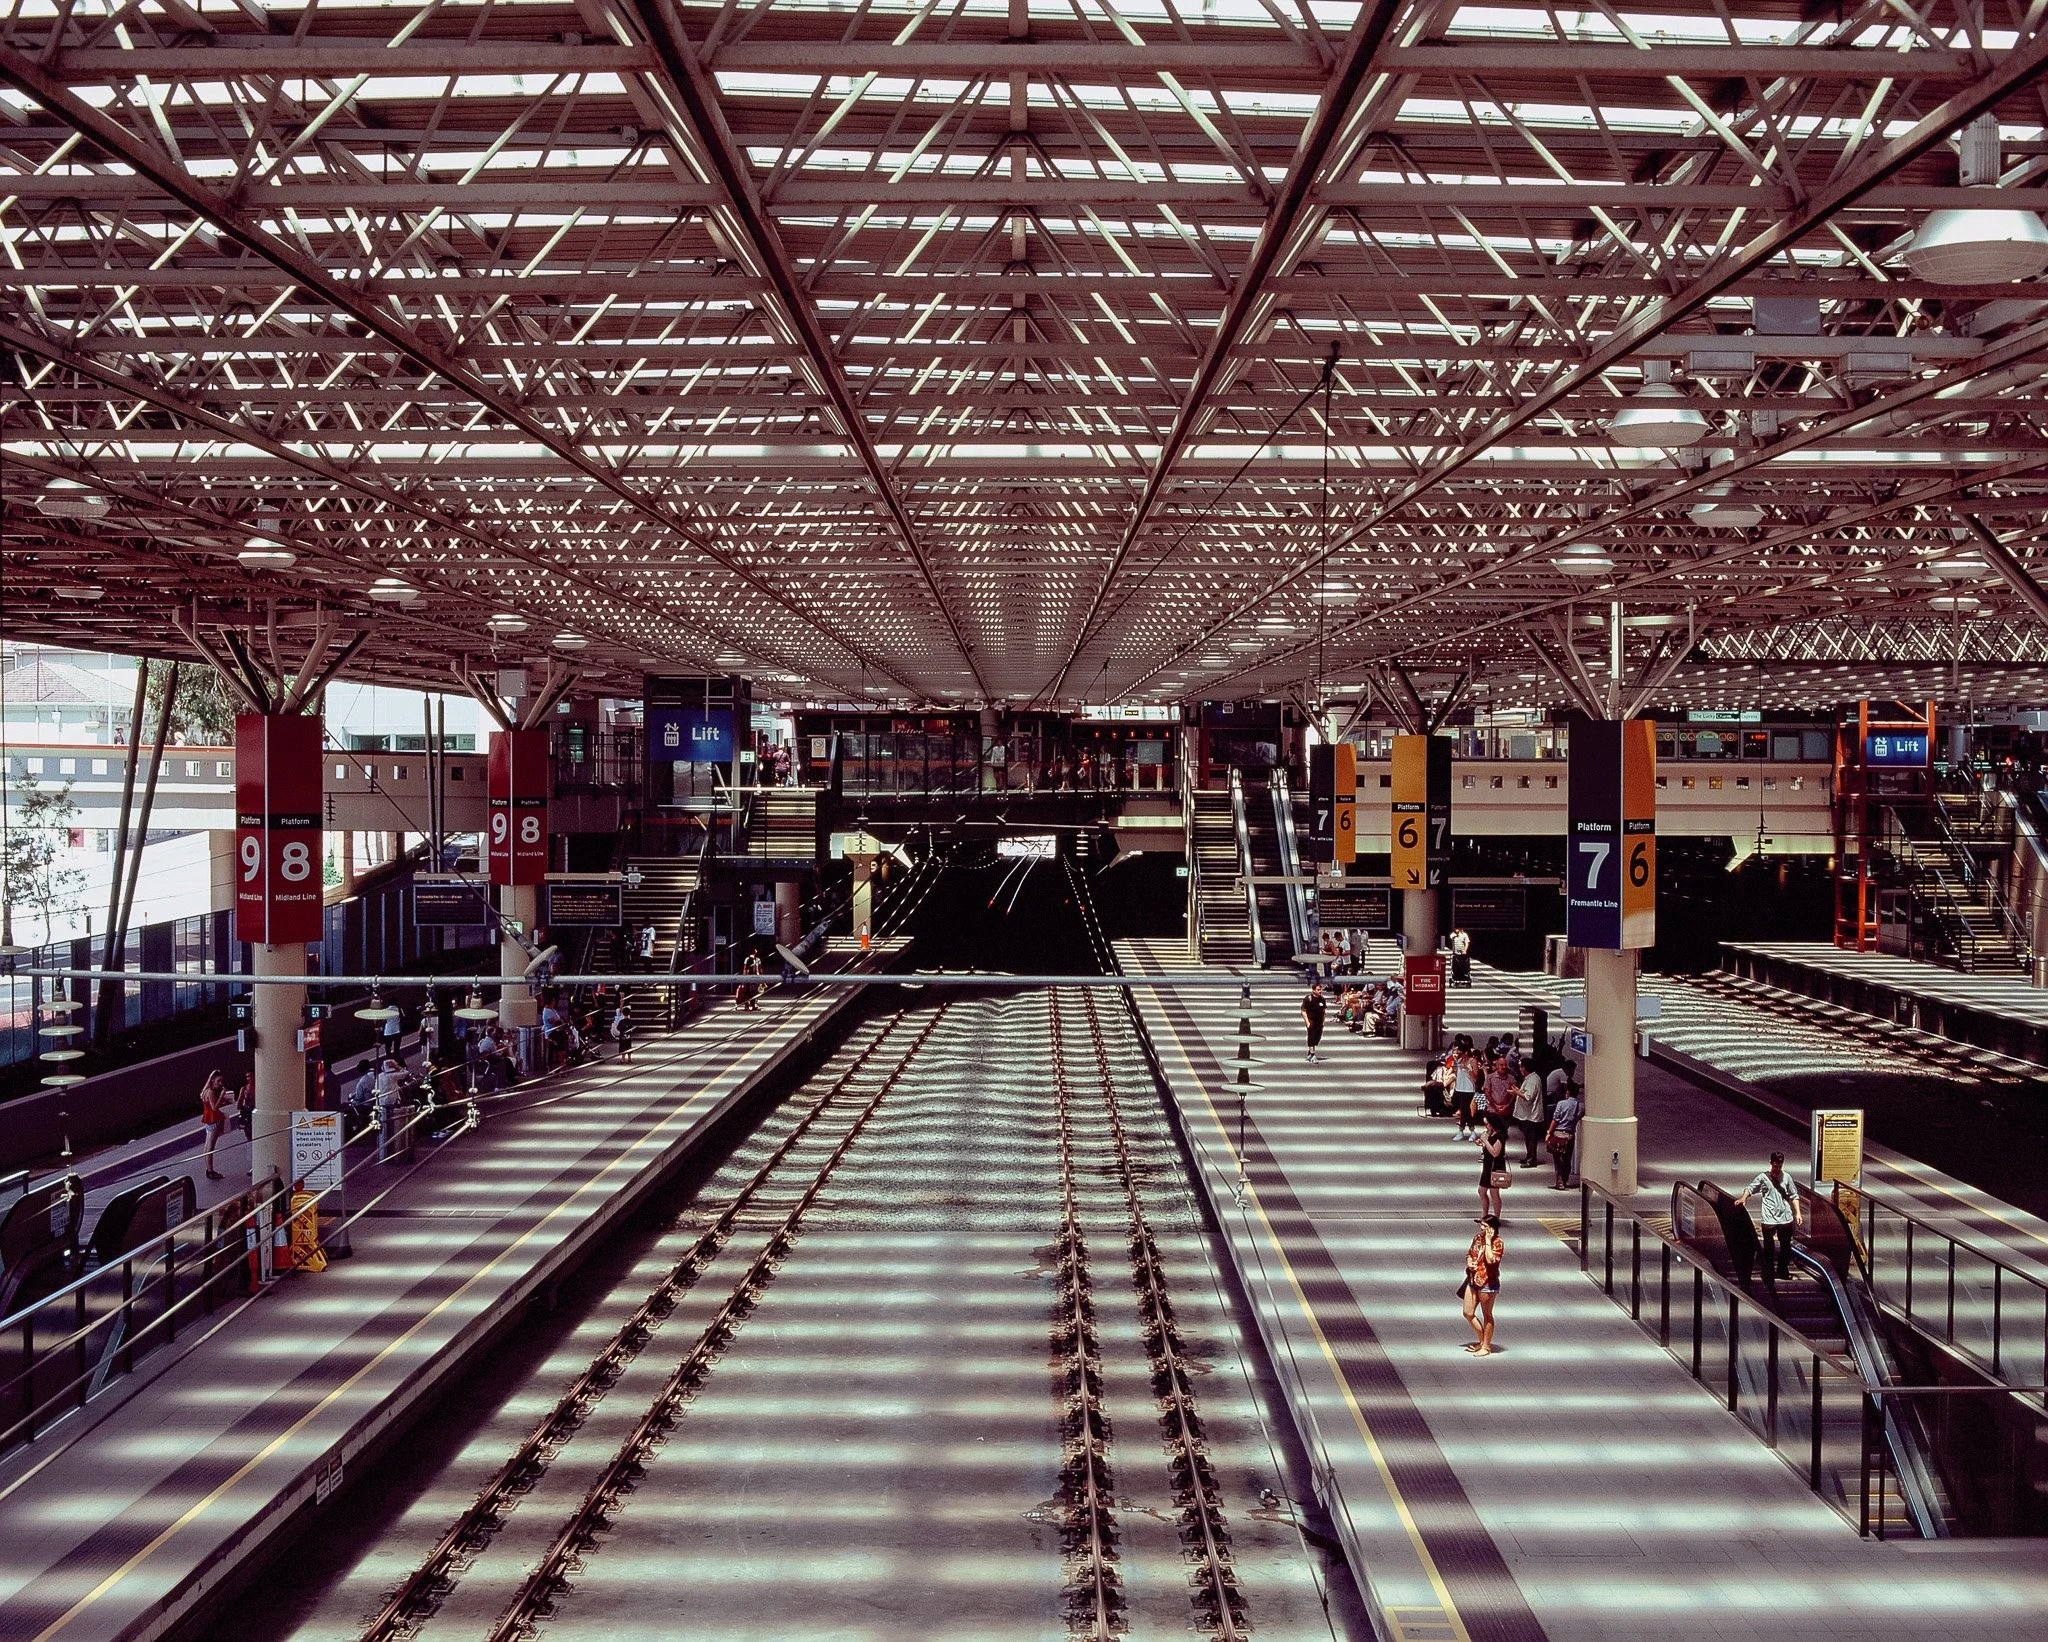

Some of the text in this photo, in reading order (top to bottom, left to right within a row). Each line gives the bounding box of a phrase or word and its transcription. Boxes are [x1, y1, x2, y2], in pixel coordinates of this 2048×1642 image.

[691, 727, 720, 741] Lift
[1896, 741, 1919, 752] Lift
[1397, 803, 1420, 811] Platform
[240, 816, 261, 825] Platform
[281, 817, 310, 825] Platform
[492, 812, 507, 845] 9
[1317, 809, 1328, 831] 7
[1340, 809, 1351, 831] 6
[1577, 822, 1612, 831] Platform
[1629, 822, 1650, 830] Platform
[521, 816, 540, 844] 8
[1398, 817, 1419, 849] 6
[1431, 817, 1447, 850] 7
[241, 836, 260, 882] 9
[281, 841, 310, 882] 8
[1579, 842, 1610, 889] 7
[1629, 841, 1649, 888] 6
[254, 893, 263, 901] Line
[275, 893, 301, 901] Midland
[1570, 899, 1618, 908] Fremantle Line
